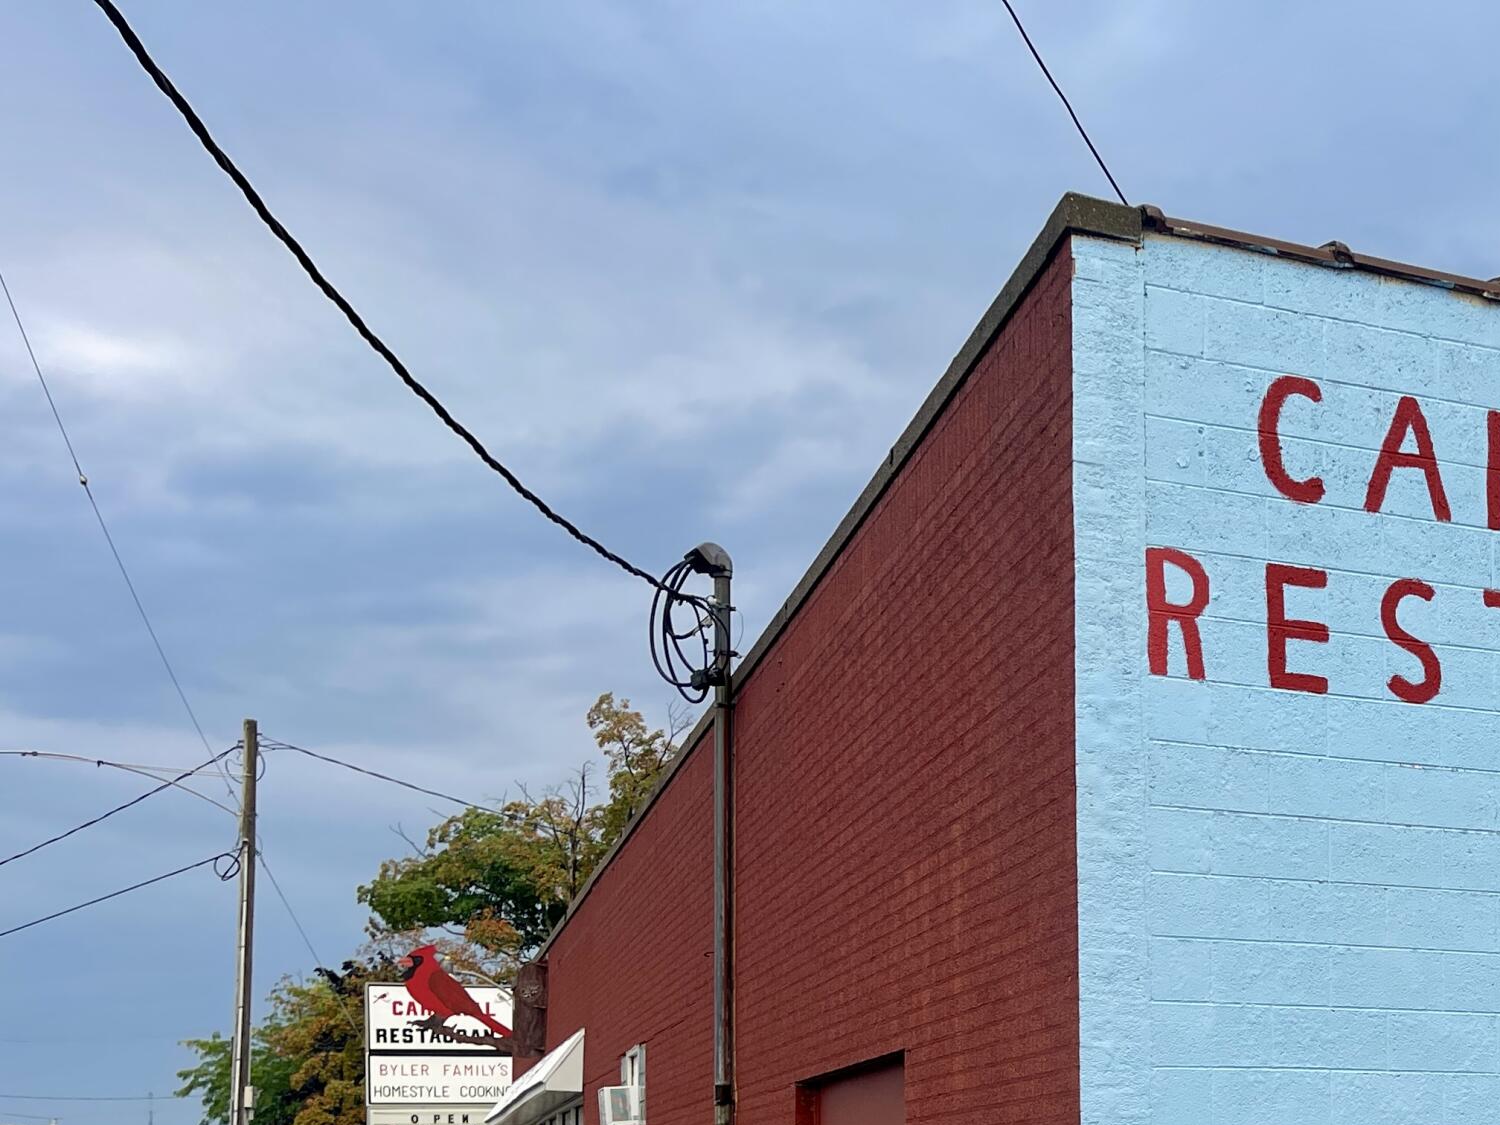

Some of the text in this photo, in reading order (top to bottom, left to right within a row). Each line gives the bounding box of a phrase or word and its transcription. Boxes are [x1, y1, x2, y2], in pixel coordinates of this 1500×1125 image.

[379, 1063, 509, 1077] BYLER FAMILY'S
[373, 1085, 449, 1098] HOMESTYLE
